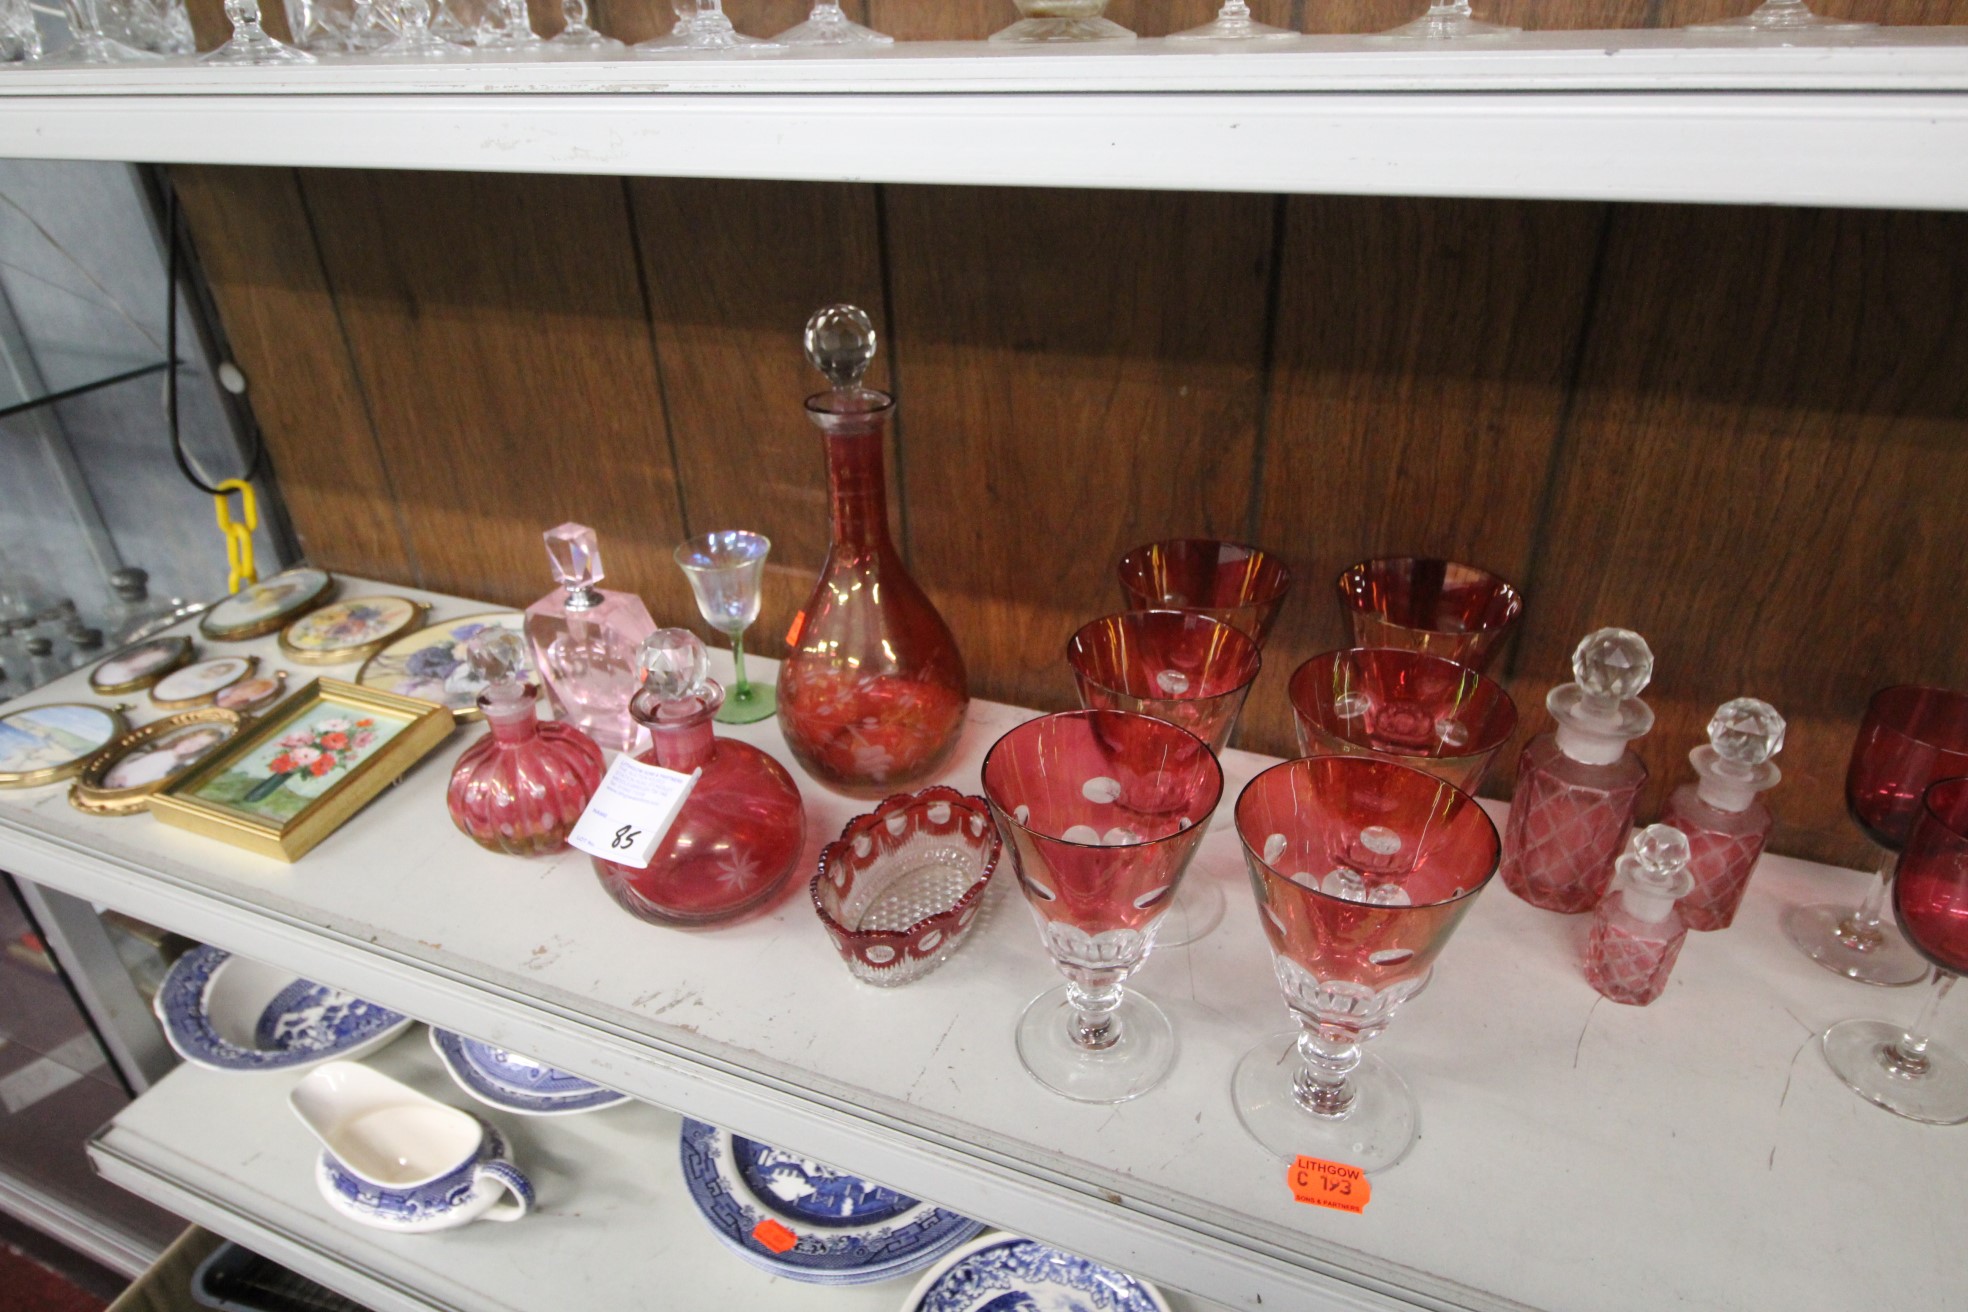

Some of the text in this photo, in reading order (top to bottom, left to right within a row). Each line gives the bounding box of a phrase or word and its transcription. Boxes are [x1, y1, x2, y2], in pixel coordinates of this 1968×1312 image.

[611, 824, 642, 850] 85
[1298, 1158, 1360, 1180] LITHGOW
[1297, 1171, 1308, 1187] C
[1323, 1200, 1360, 1213] PARTNERS
